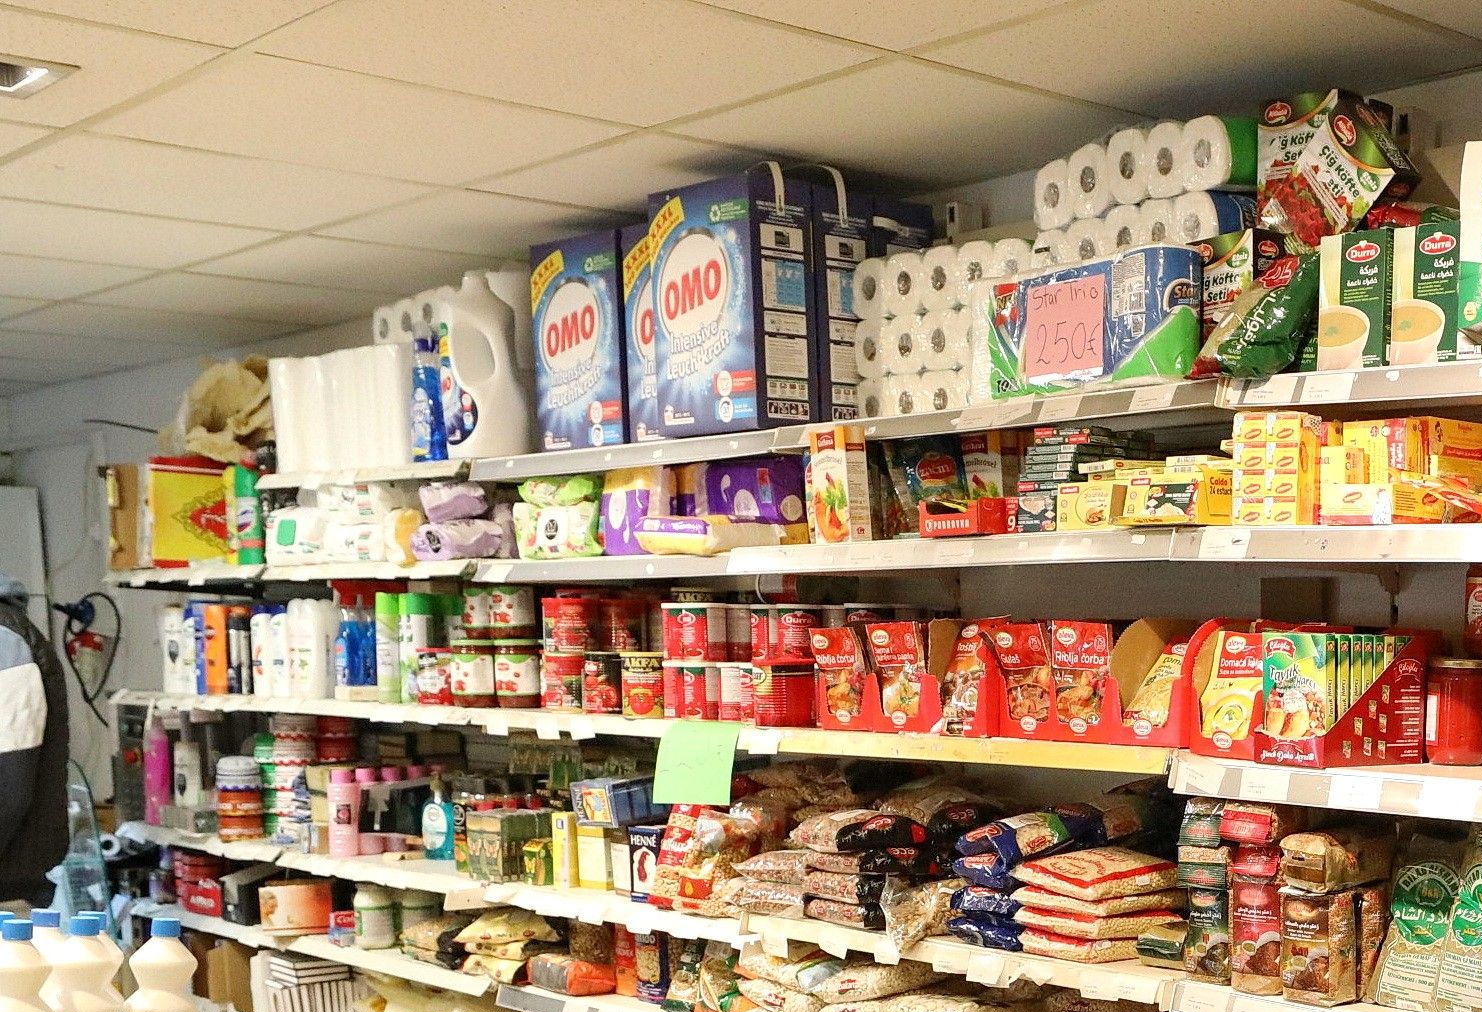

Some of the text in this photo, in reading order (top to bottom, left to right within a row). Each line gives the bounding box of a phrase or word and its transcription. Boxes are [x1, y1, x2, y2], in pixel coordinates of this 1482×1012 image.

[1335, 165, 1360, 198] Köfte
[1424, 238, 1454, 251] Durra
[1351, 249, 1377, 258] Durra
[1359, 266, 1378, 275] فريكة
[1433, 258, 1455, 270] فريكة
[664, 259, 721, 320] OMO
[1033, 283, 1098, 310] Star Trio
[546, 303, 595, 357] OMO
[784, 614, 817, 625] Durra
[1055, 651, 1078, 664] Riblja
[1269, 665, 1299, 681] Tavuk
[630, 834, 657, 846] HENNÉ
